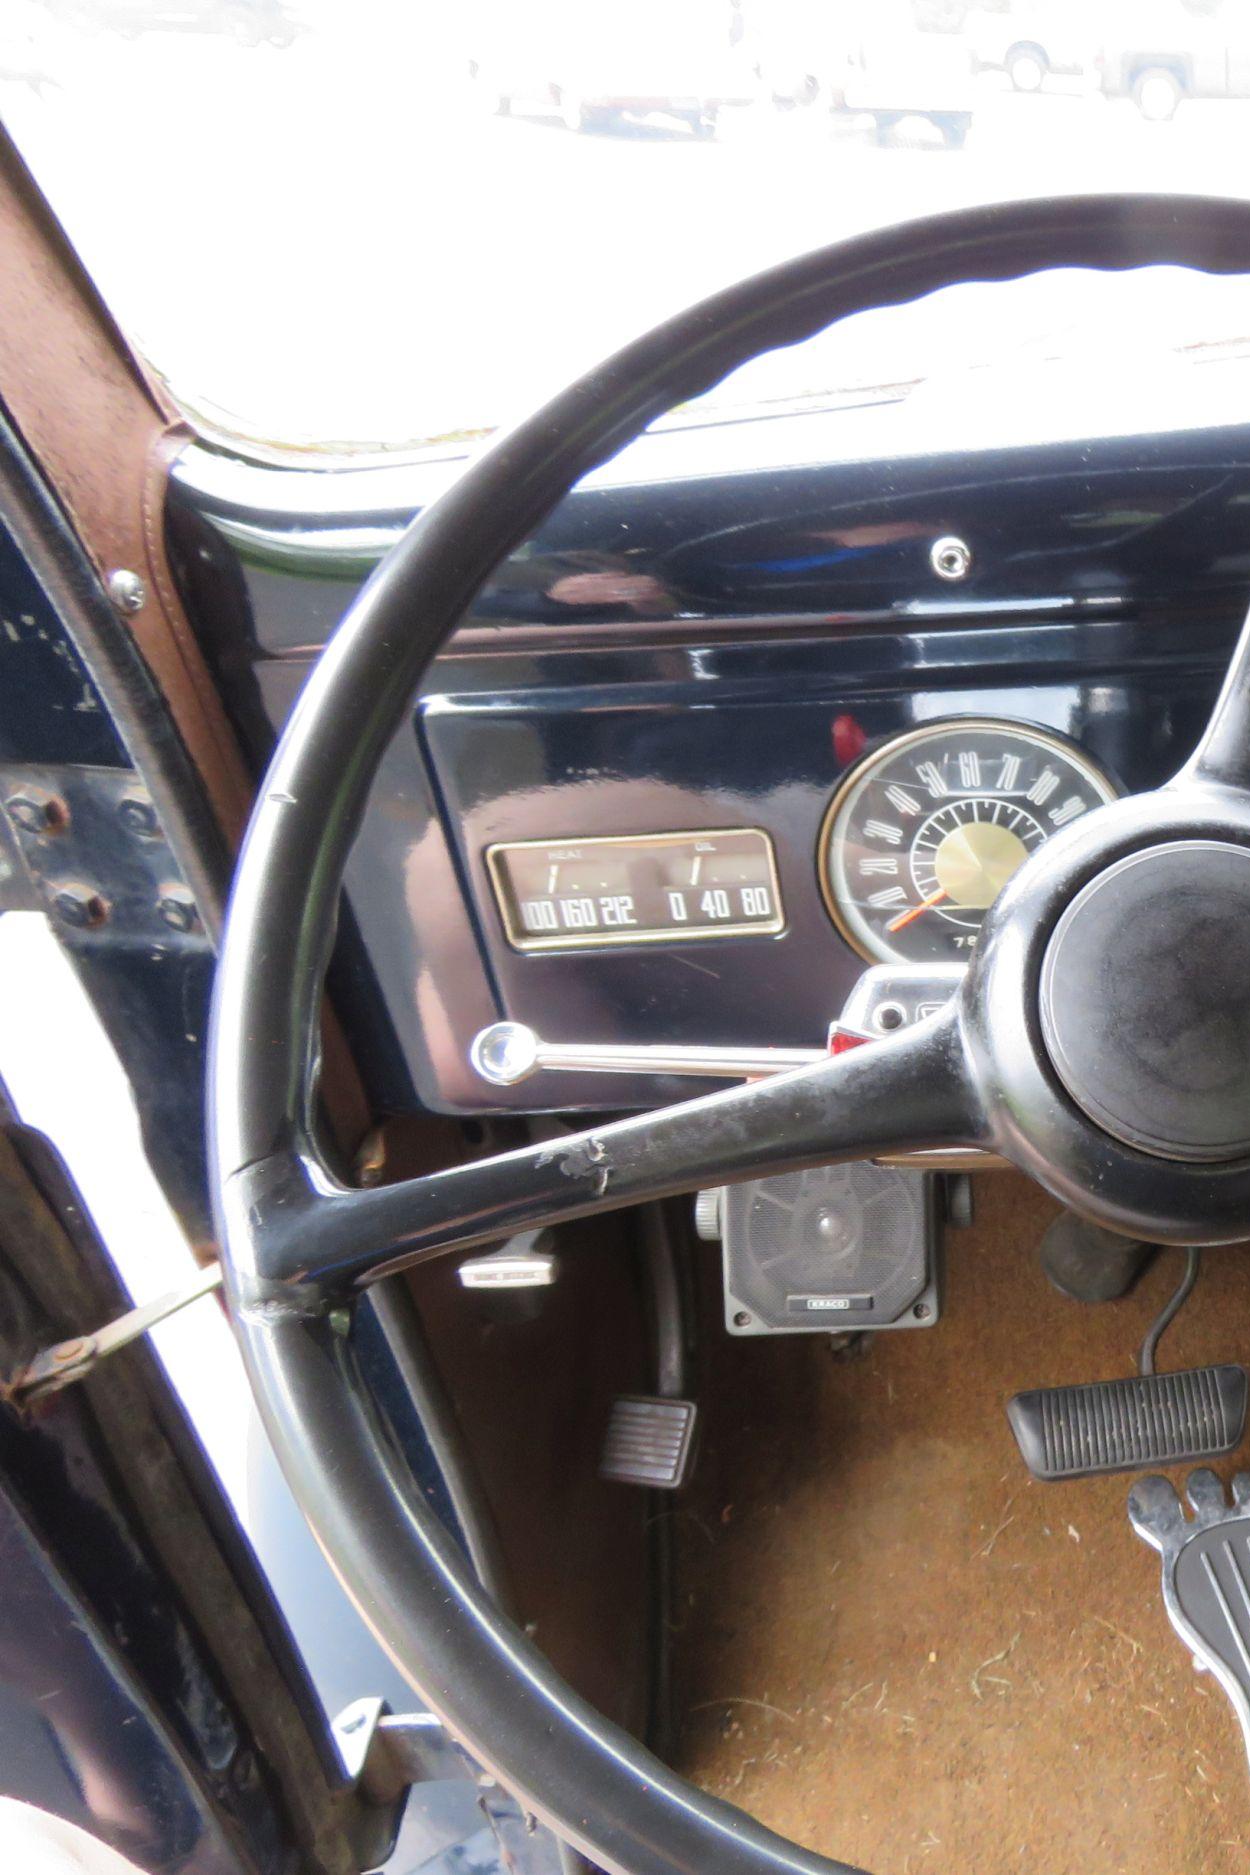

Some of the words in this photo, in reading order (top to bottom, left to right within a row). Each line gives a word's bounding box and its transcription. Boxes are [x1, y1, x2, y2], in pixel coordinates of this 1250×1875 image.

[915, 761, 948, 798] 50
[957, 751, 981, 788] 60
[995, 753, 1021, 790] 70
[884, 785, 921, 816] 40
[1026, 770, 1060, 806] 80
[1048, 795, 1087, 826] 90
[695, 842, 717, 852] OIL
[862, 819, 903, 845] 30
[547, 849, 582, 861] HEAT
[859, 858, 898, 876] 20
[520, 900, 559, 931] 100
[560, 898, 598, 928] 160
[599, 896, 638, 926] 212
[668, 892, 688, 921] 0
[701, 889, 731, 919] 40
[740, 887, 771, 916] 80
